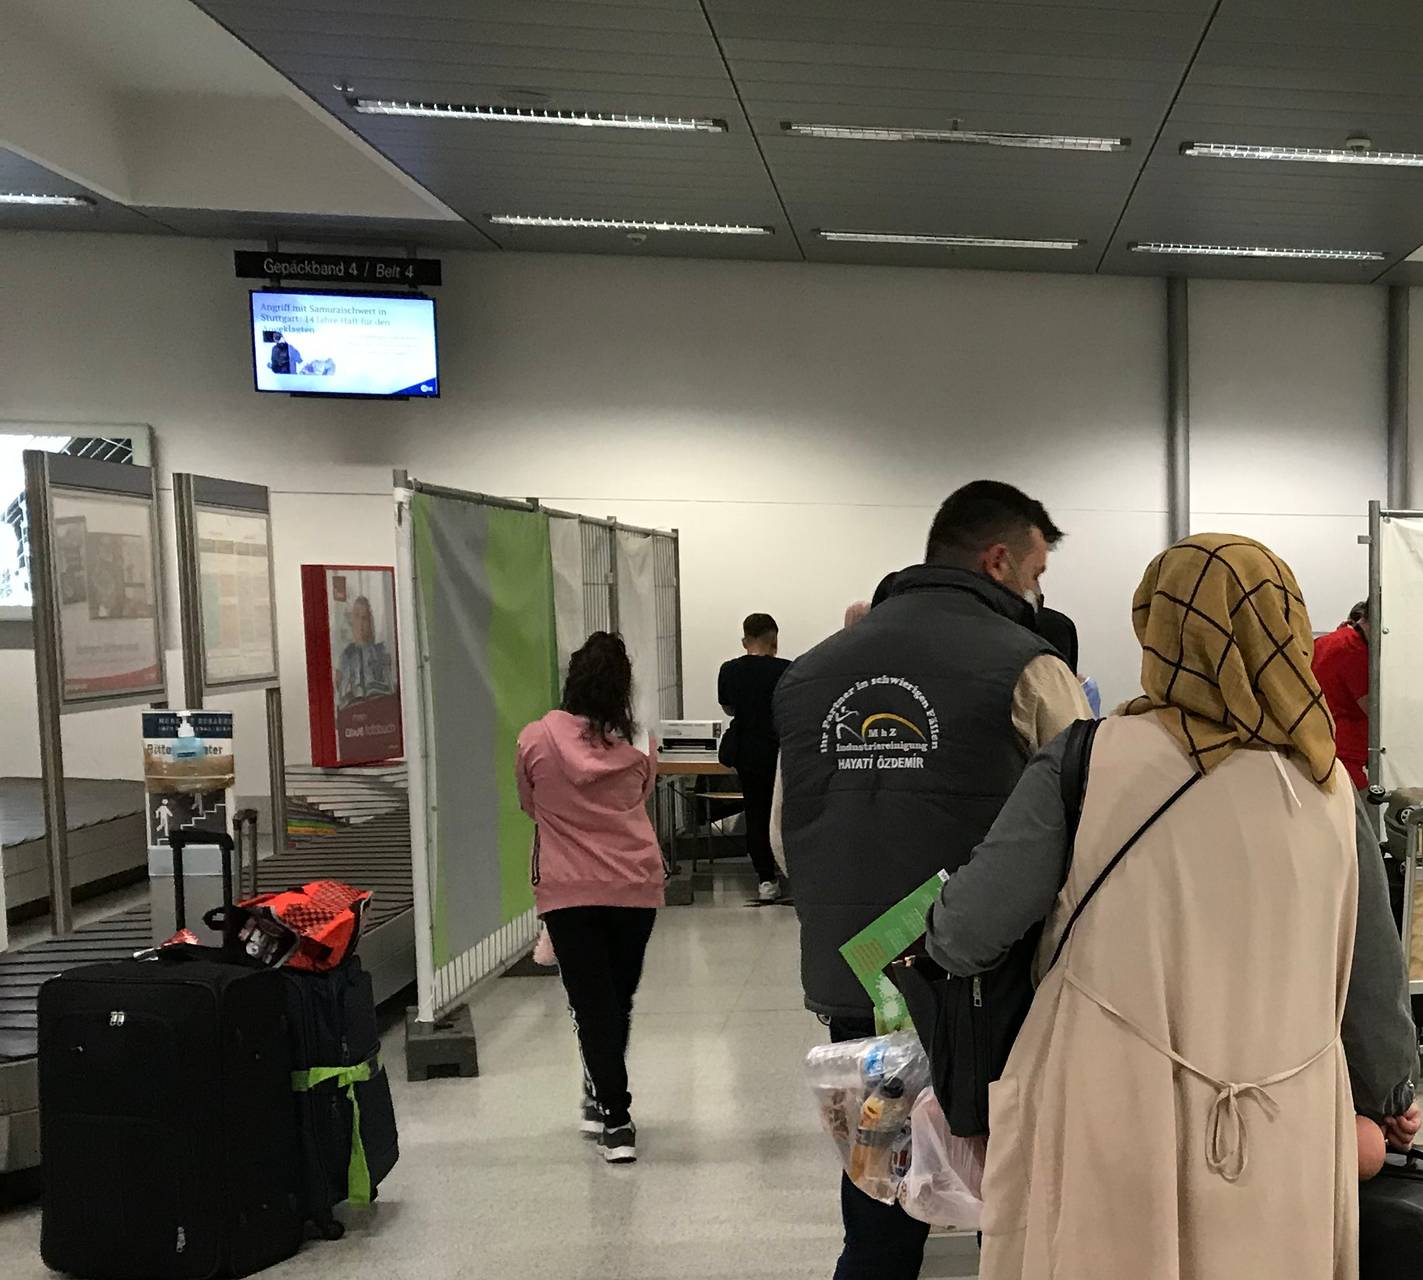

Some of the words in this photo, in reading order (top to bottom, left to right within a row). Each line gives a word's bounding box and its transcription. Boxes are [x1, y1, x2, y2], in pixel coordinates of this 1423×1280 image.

[263, 257, 345, 277] Gepäckband
[349, 262, 358, 276] 4
[376, 263, 401, 278] Belt
[405, 265, 415, 278] 4
[871, 674, 930, 709] schwierigen
[822, 687, 855, 730] Partner
[888, 728, 897, 737] Z
[926, 708, 940, 750] Fällen
[820, 732, 829, 753] Ihr
[835, 741, 928, 752] Industriereinigung
